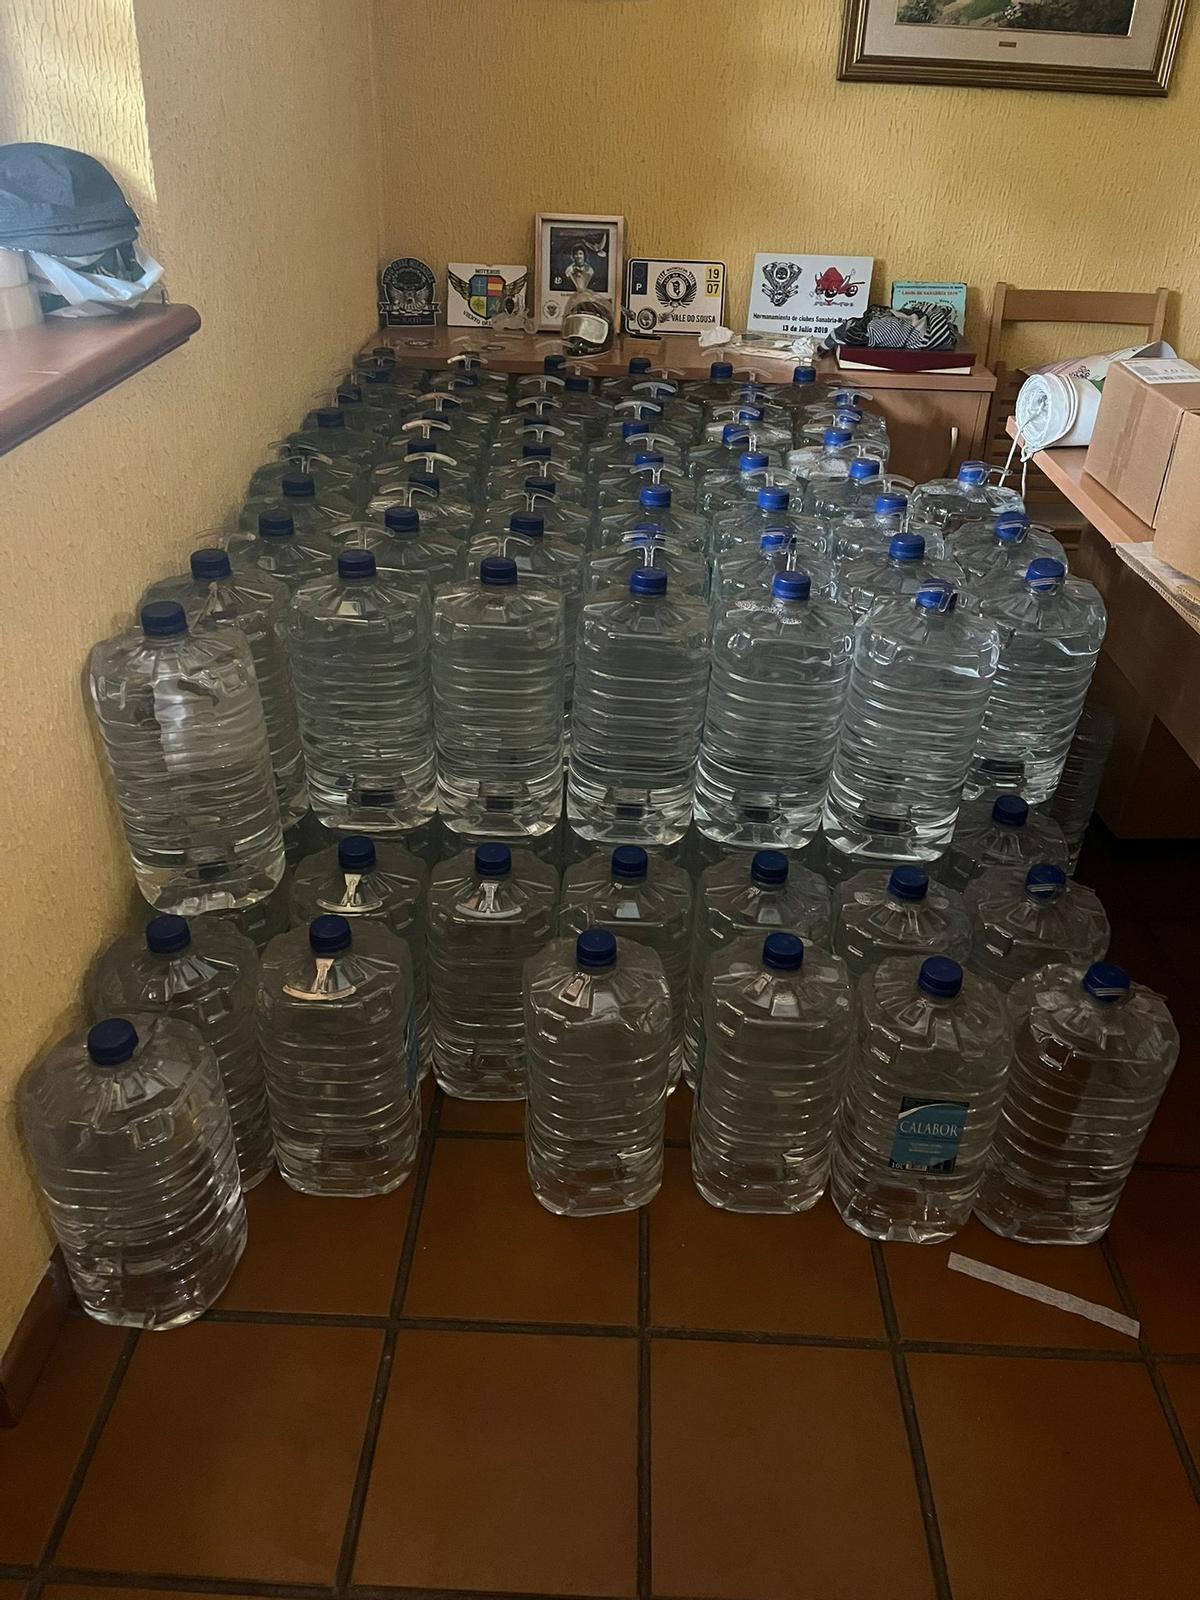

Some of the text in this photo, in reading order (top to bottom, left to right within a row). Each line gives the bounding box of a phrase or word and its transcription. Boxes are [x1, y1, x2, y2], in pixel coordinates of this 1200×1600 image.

[708, 268, 720, 280] 19
[636, 283, 643, 292] P
[706, 283, 719, 294] 07
[671, 314, 686, 323] VALE
[686, 314, 695, 323] DO
[696, 315, 716, 323] SOUSA
[798, 325, 813, 333] Julio
[814, 326, 829, 334] 2019
[899, 1120, 958, 1137] CALABOR
